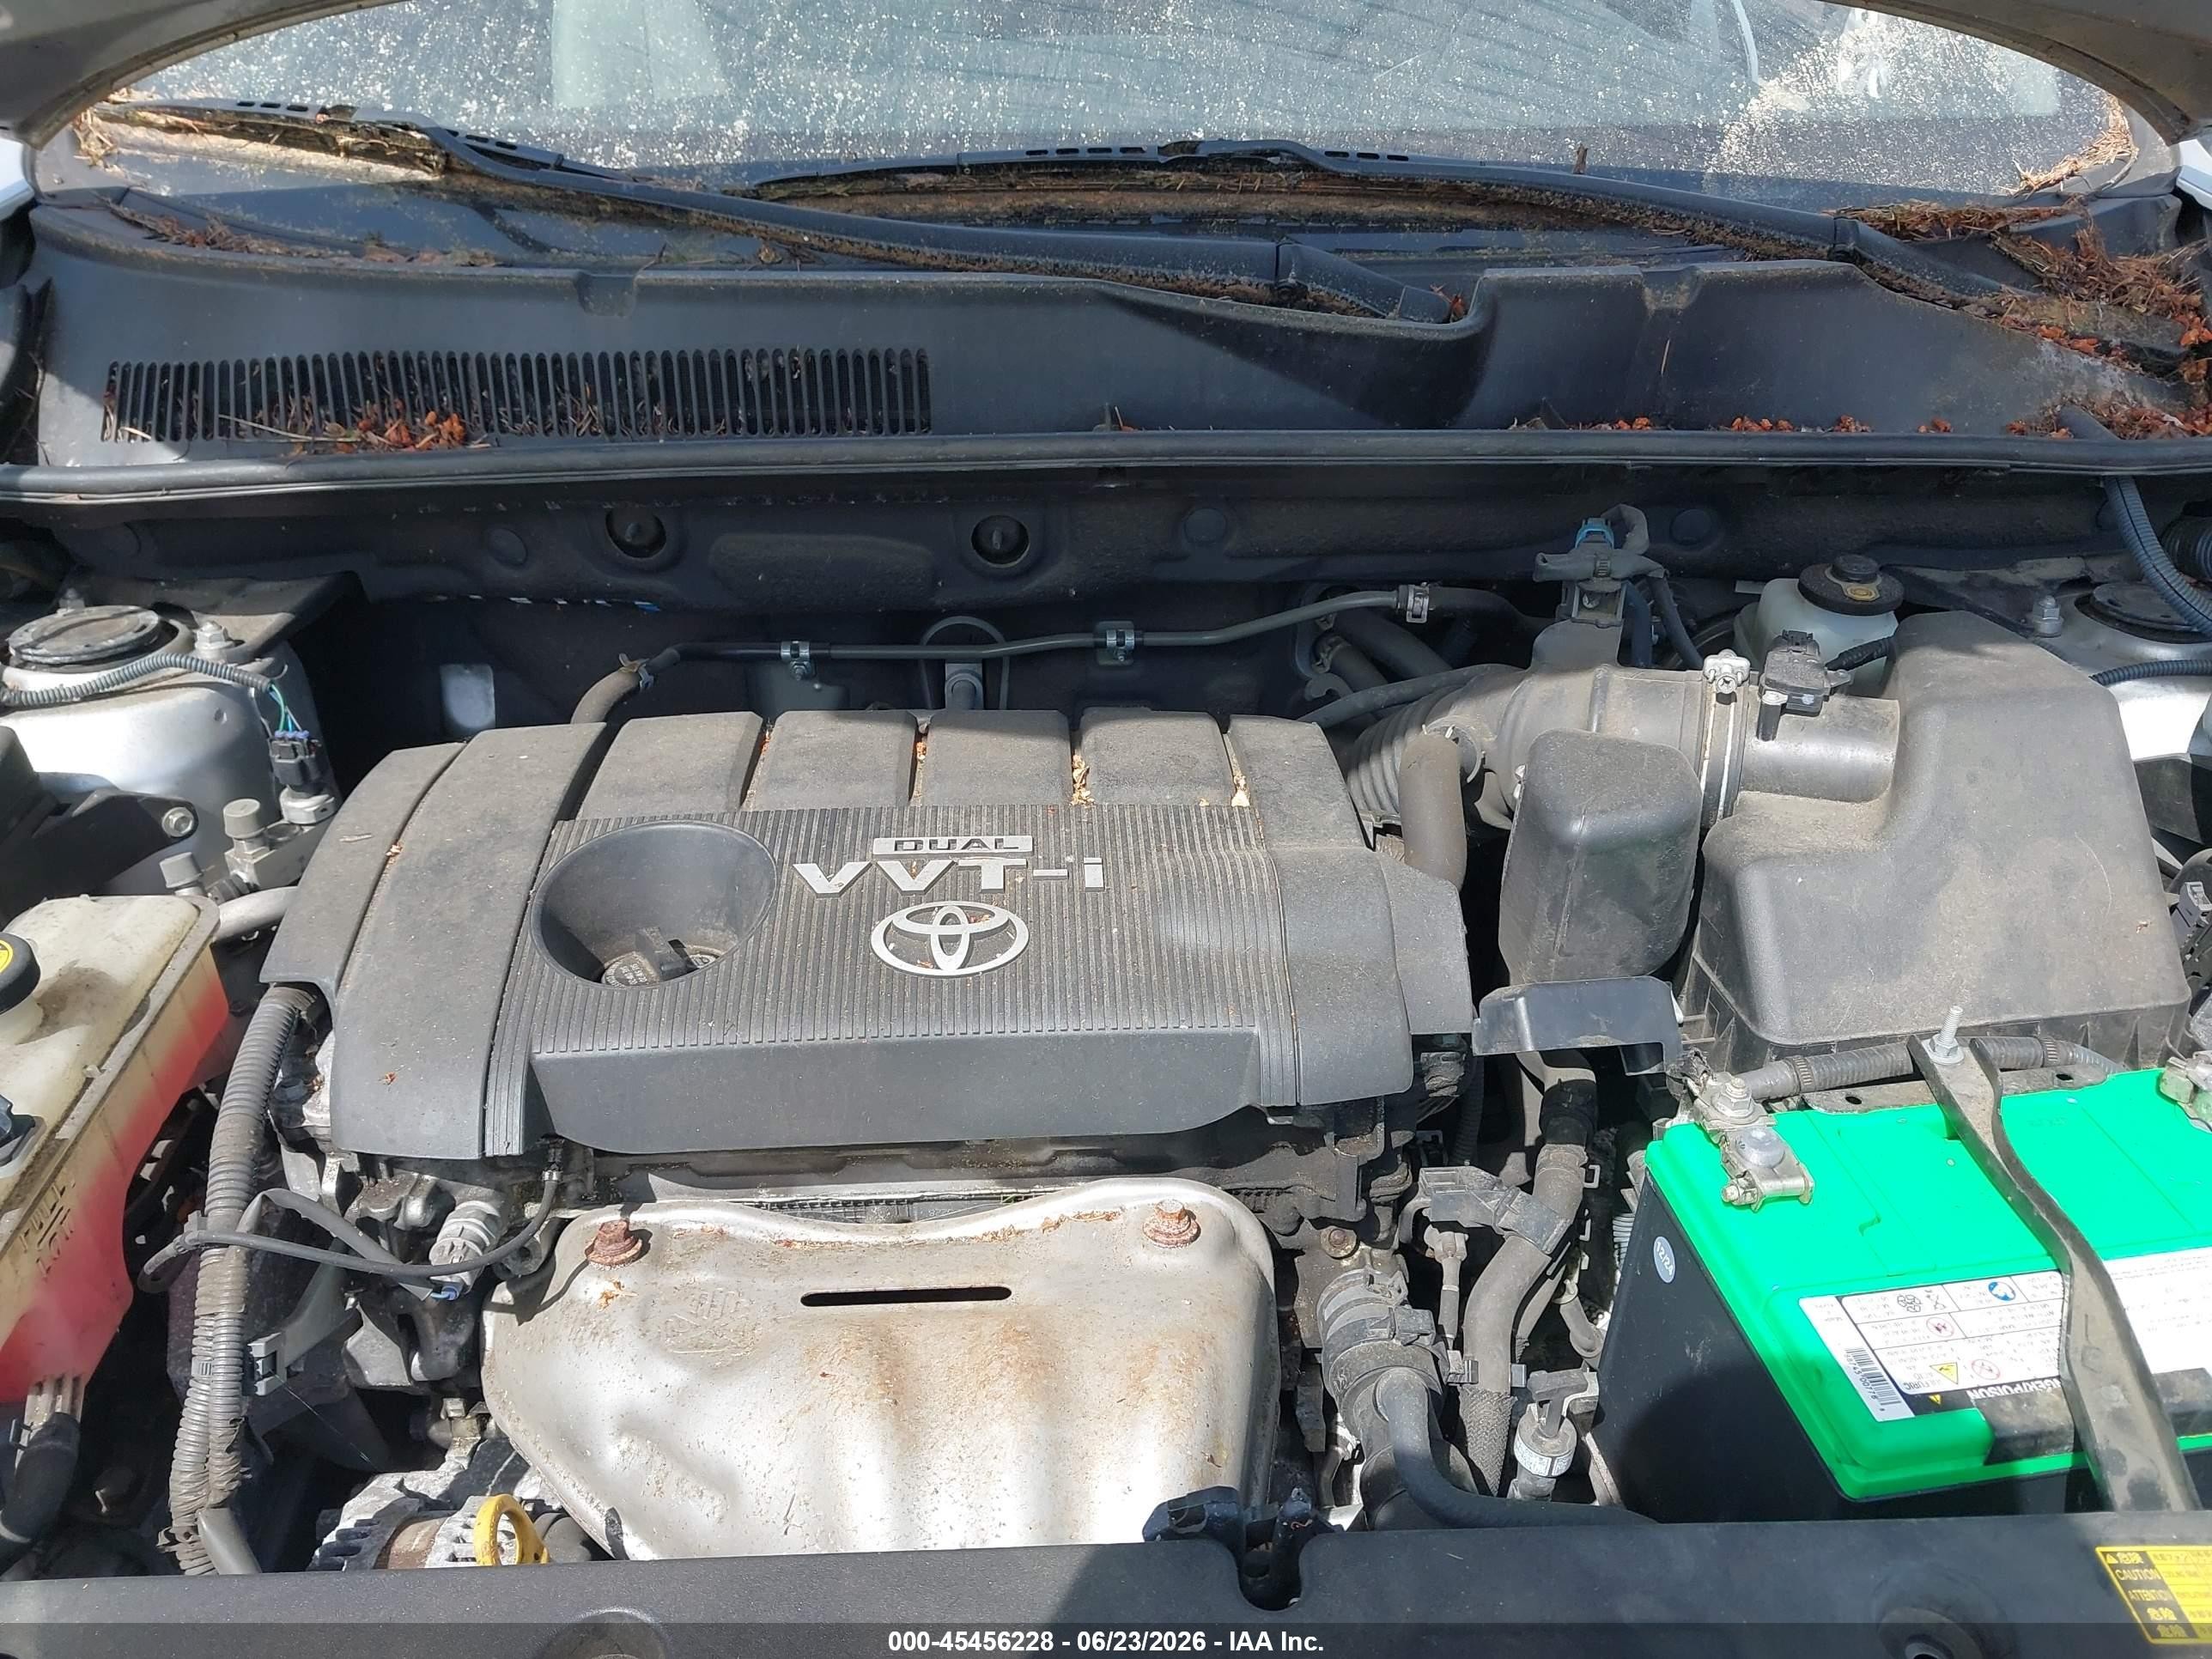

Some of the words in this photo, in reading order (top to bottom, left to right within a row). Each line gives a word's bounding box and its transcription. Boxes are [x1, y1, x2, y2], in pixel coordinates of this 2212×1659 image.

[894, 838, 1020, 852] DUAL
[793, 857, 1105, 896] VVT-i
[2115, 1569, 2162, 1580] CAUTION
[2128, 1589, 2175, 1601] ATTENTION
